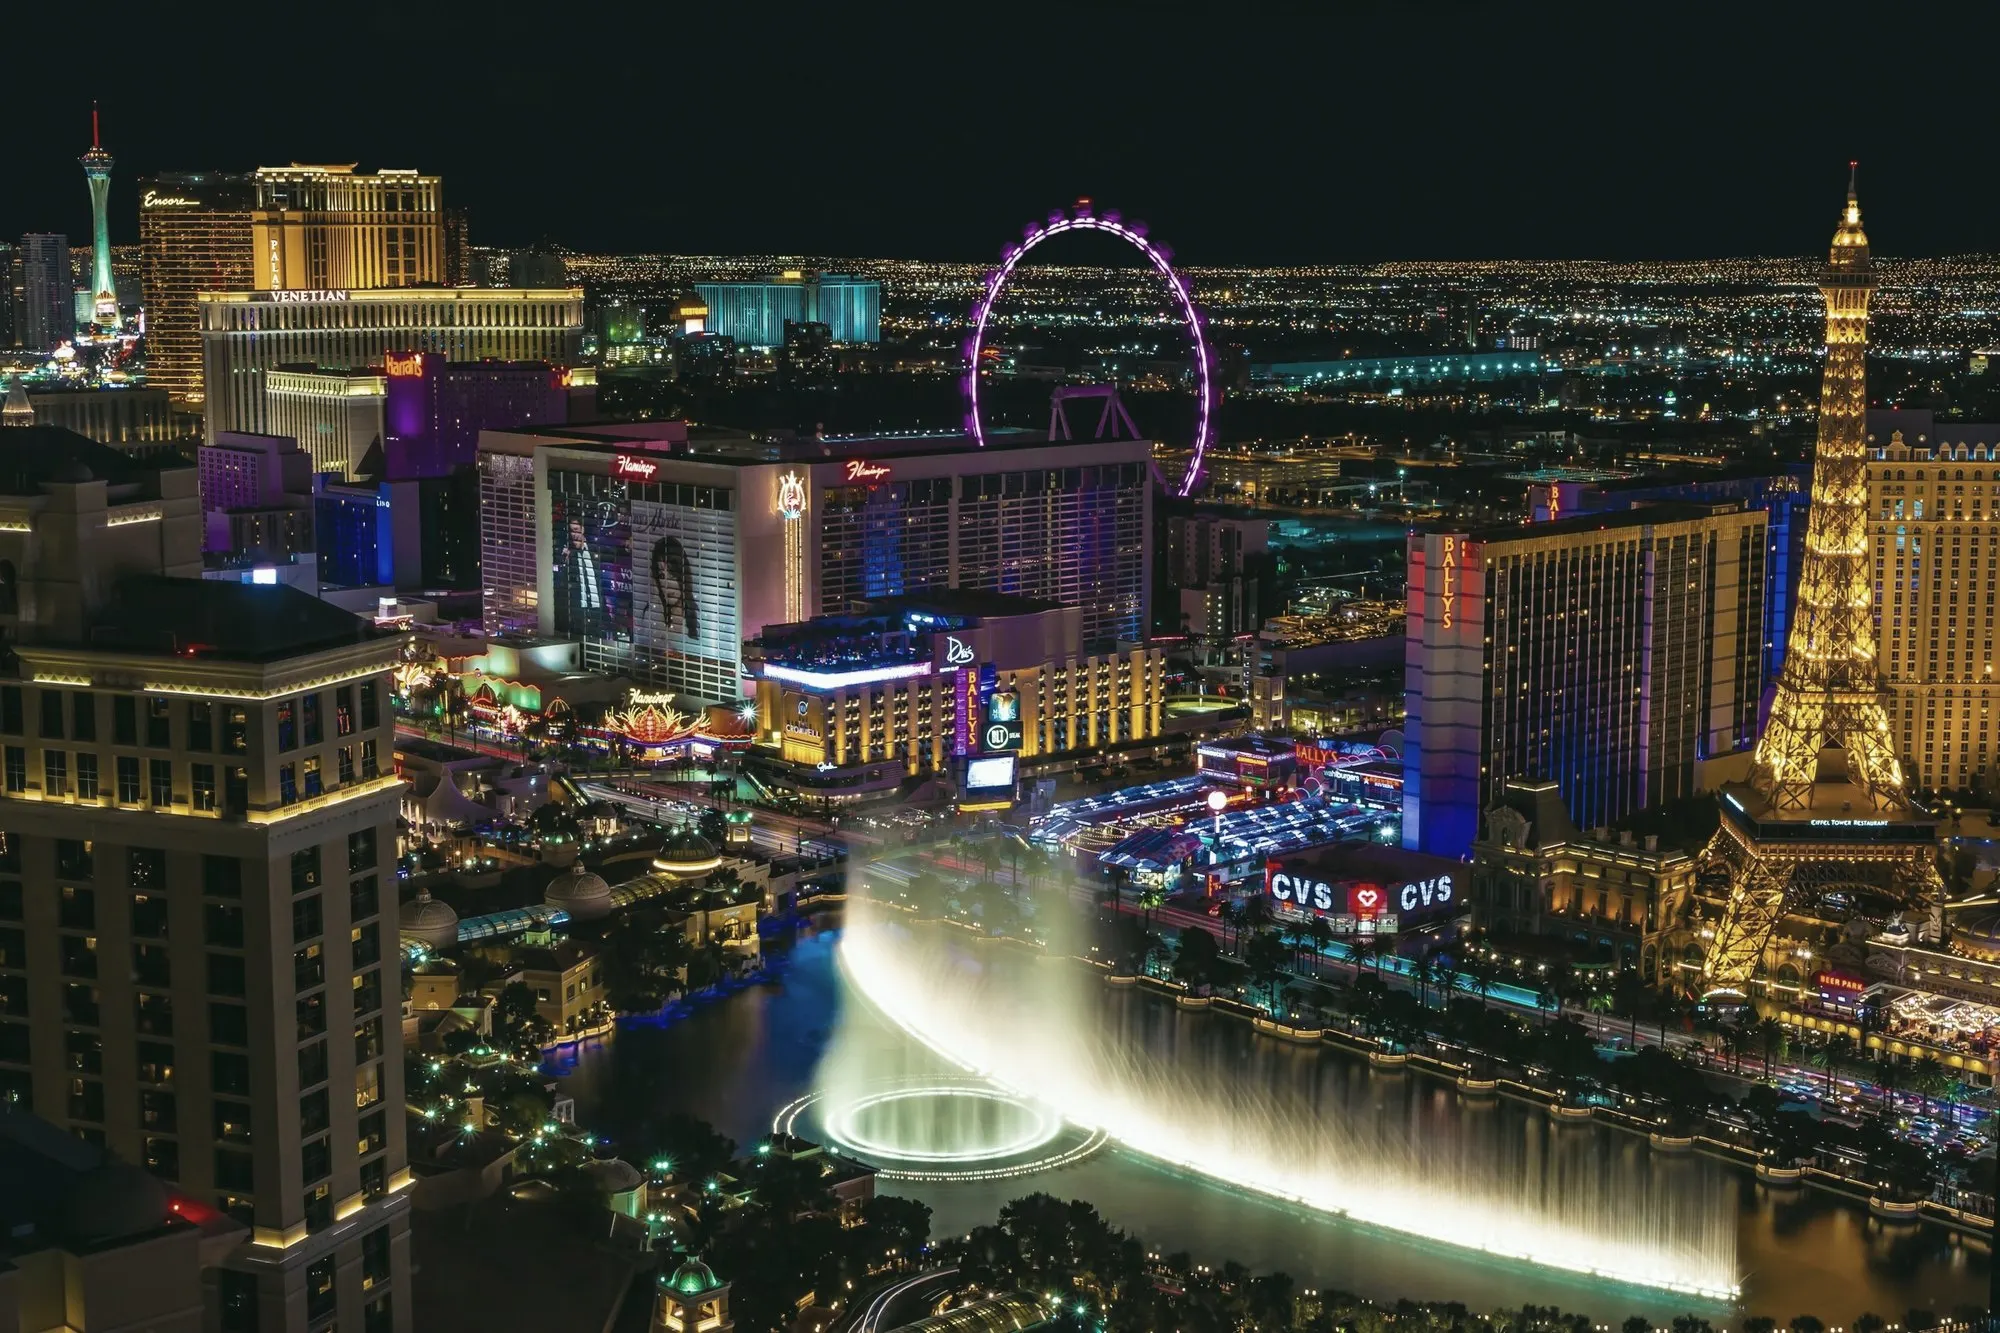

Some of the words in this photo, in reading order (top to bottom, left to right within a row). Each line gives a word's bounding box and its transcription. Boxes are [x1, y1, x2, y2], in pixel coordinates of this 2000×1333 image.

[144, 191, 200, 207] Encore
[271, 290, 346, 302] VENETIAN
[618, 456, 656, 478] Flamingo
[846, 461, 890, 480] Flamingo
[1441, 536, 1455, 629] BALLYS
[629, 688, 675, 708] Flamingo
[967, 671, 978, 745] BALLYS
[991, 729, 1004, 744] BLT
[1296, 743, 1338, 763] BALLY'S
[1323, 769, 1360, 784] wahlburgers
[1271, 873, 1332, 910] CVS
[1401, 875, 1452, 911] CVS
[1820, 975, 1840, 987] BEER
[1841, 980, 1863, 992] PARK
